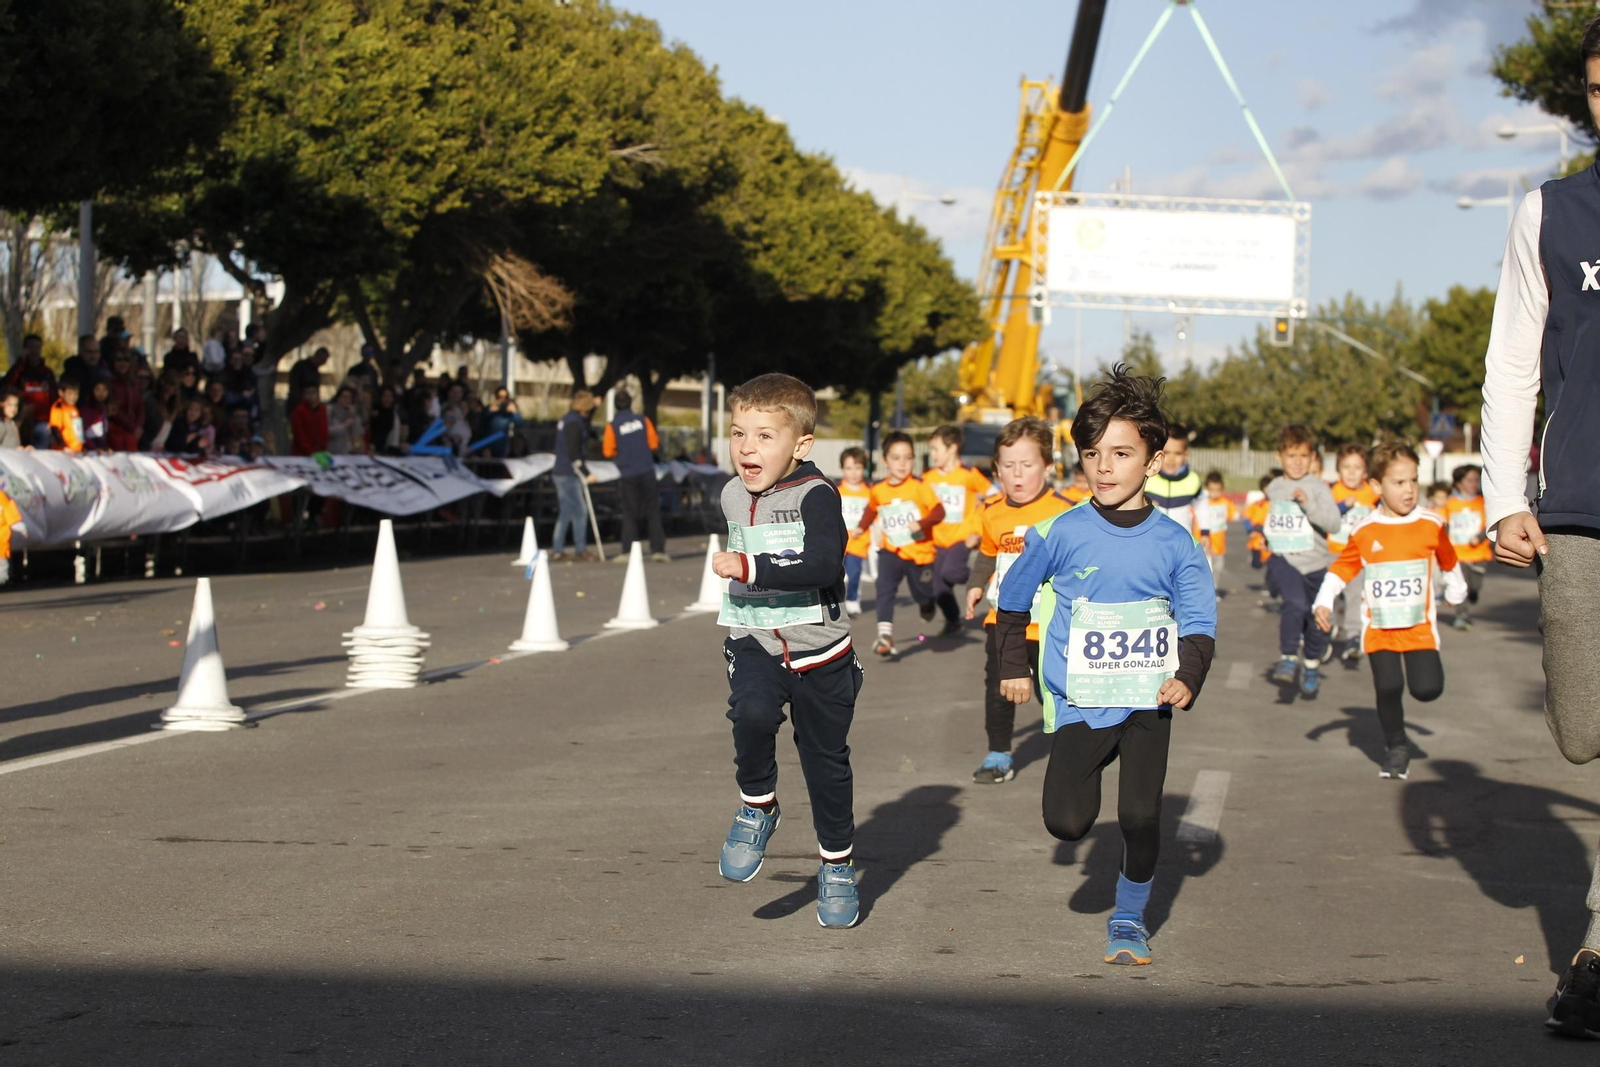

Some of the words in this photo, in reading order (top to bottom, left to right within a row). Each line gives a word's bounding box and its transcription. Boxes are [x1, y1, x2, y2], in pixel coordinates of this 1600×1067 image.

[1269, 514, 1305, 529] 8487
[763, 529, 798, 537] CARRERA
[766, 537, 800, 546] INFANTIL
[1372, 577, 1423, 599] 8253
[1083, 627, 1169, 661] 8348
[1088, 661, 1120, 670] SUPER
[1123, 659, 1165, 669] GONZALO
